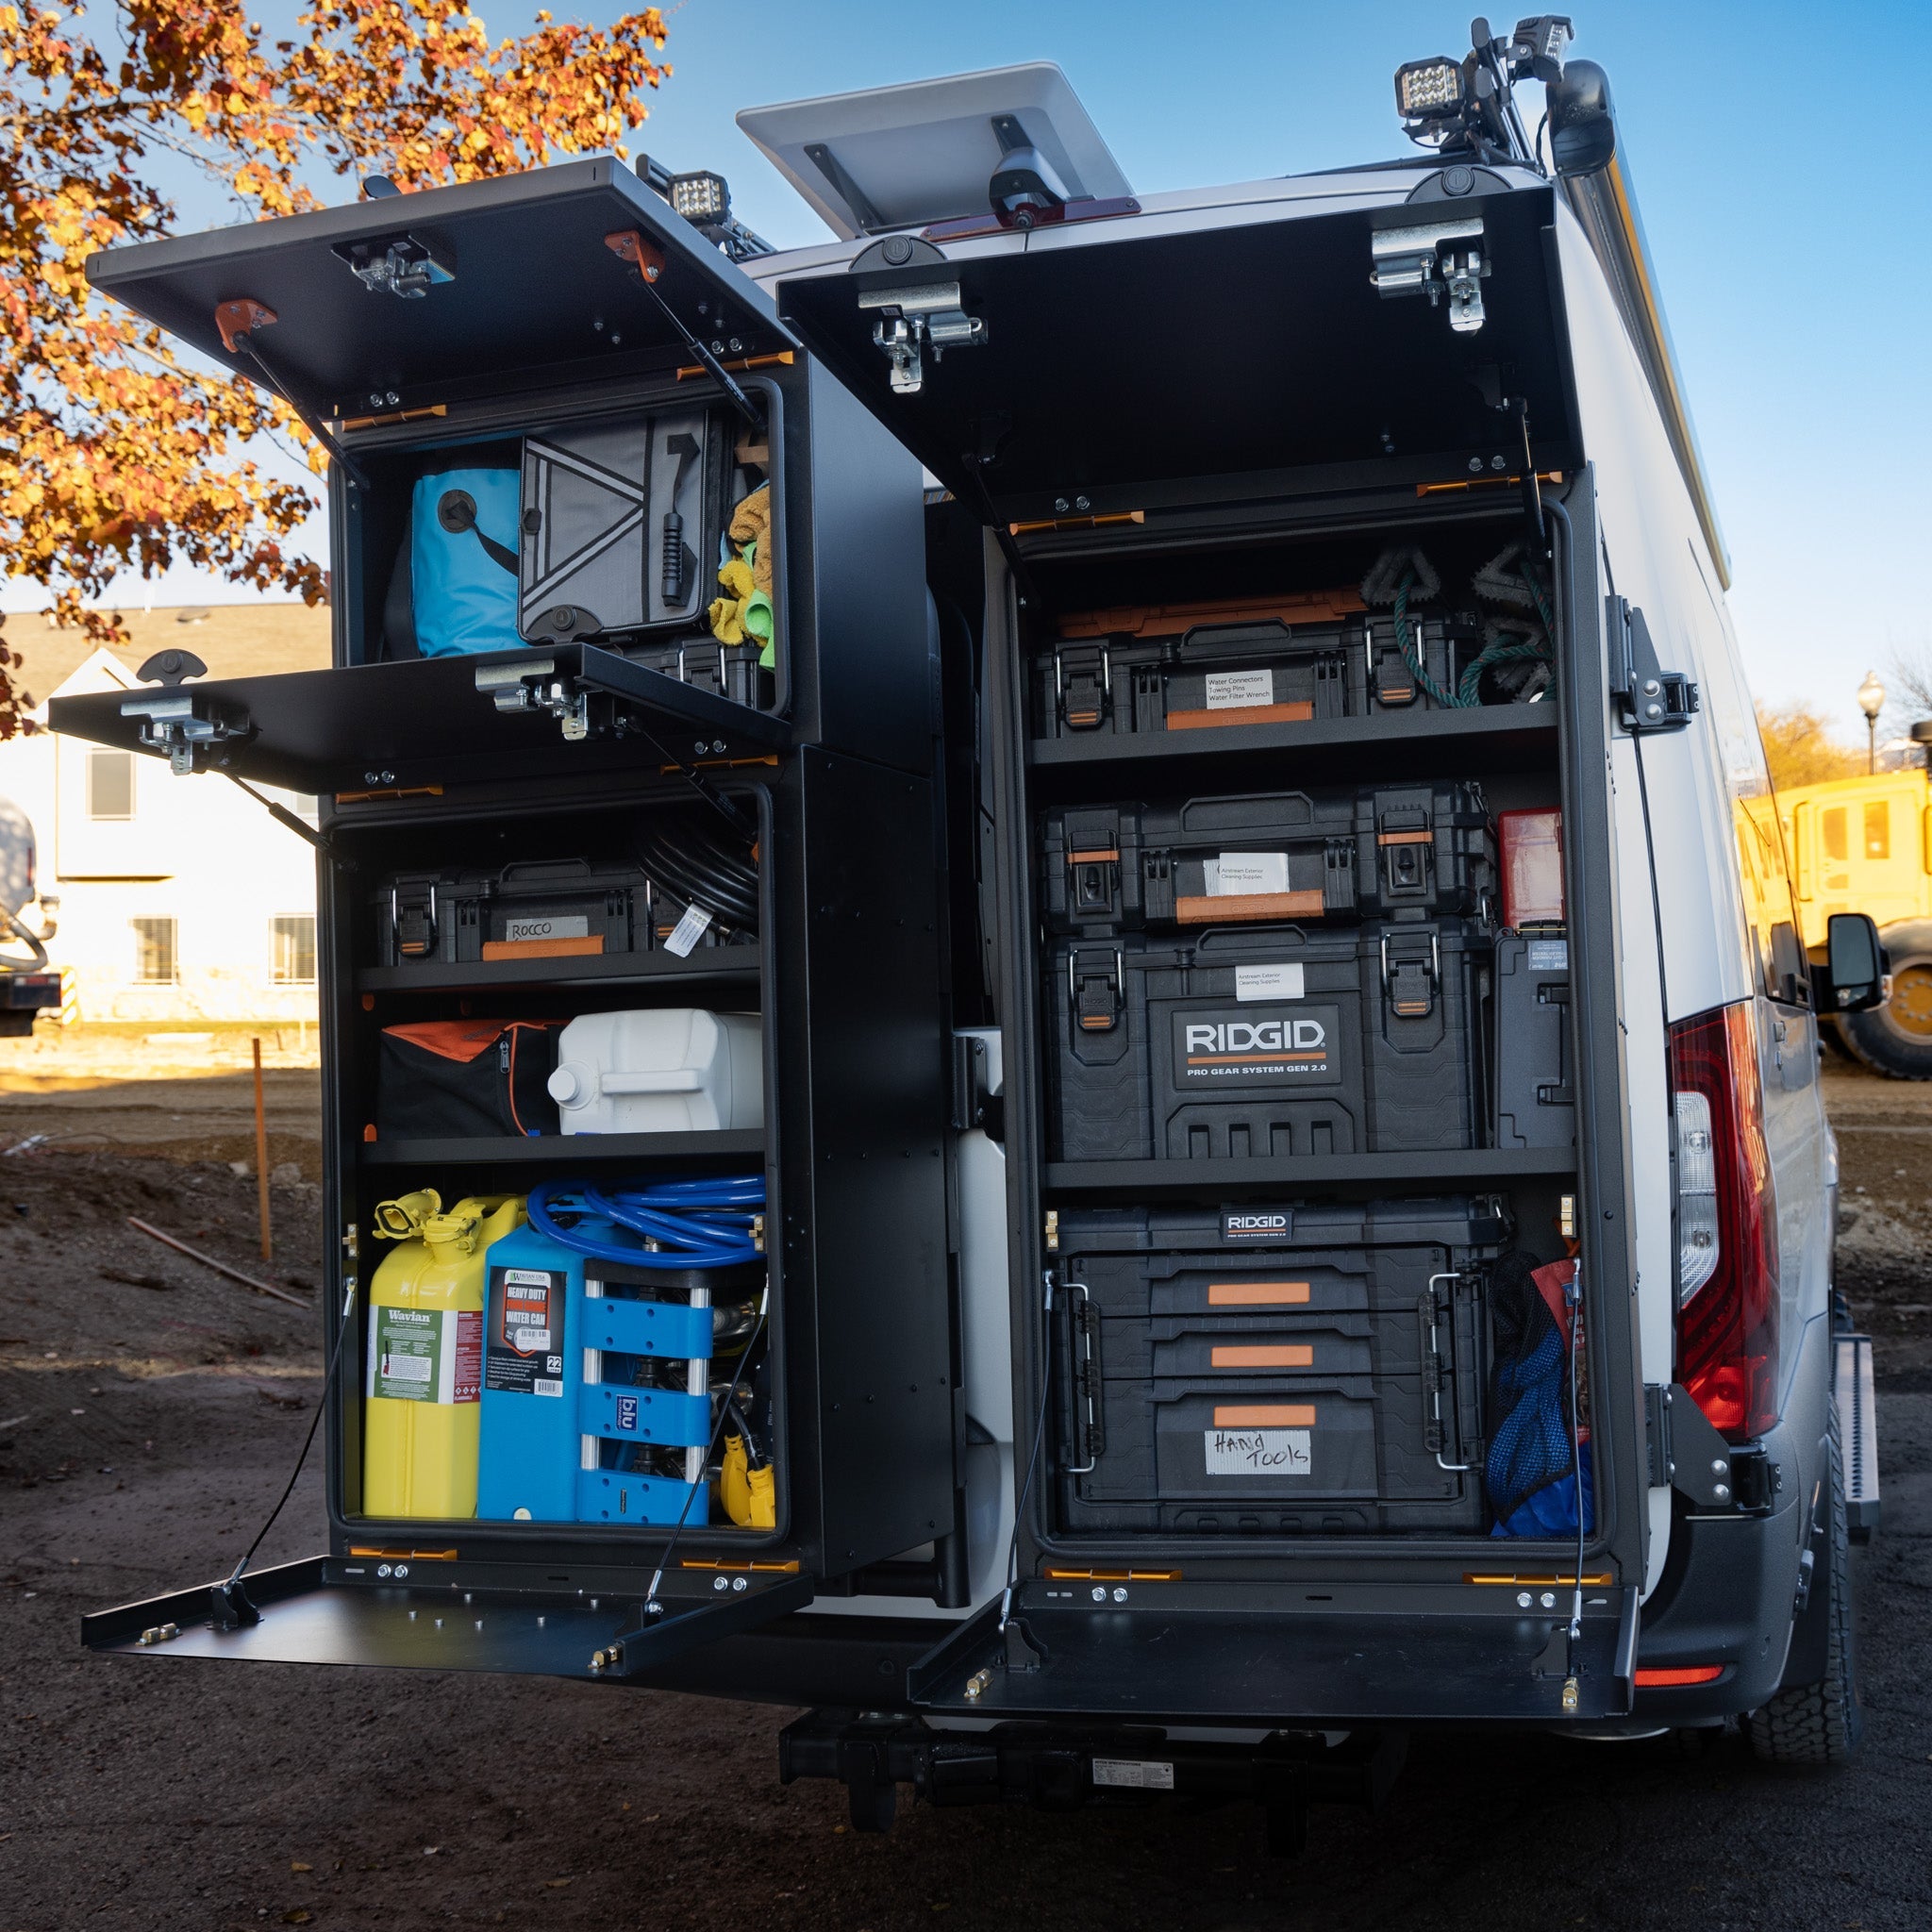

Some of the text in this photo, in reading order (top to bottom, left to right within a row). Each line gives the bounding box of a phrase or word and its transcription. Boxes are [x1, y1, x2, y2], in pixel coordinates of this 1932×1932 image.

[1228, 676, 1264, 685] Connectors
[1186, 1020, 1325, 1053] RIDGID
[1210, 1067, 1240, 1075] GEAR
[1241, 1066, 1284, 1074] SYSTEM
[1227, 1215, 1287, 1228] RIDGID
[507, 1286, 547, 1301] HEAVY DUTY
[389, 1309, 431, 1323] Wavian
[506, 1310, 546, 1325] WATER CAN
[548, 1357, 561, 1369] 22
[622, 1398, 636, 1429] blu
